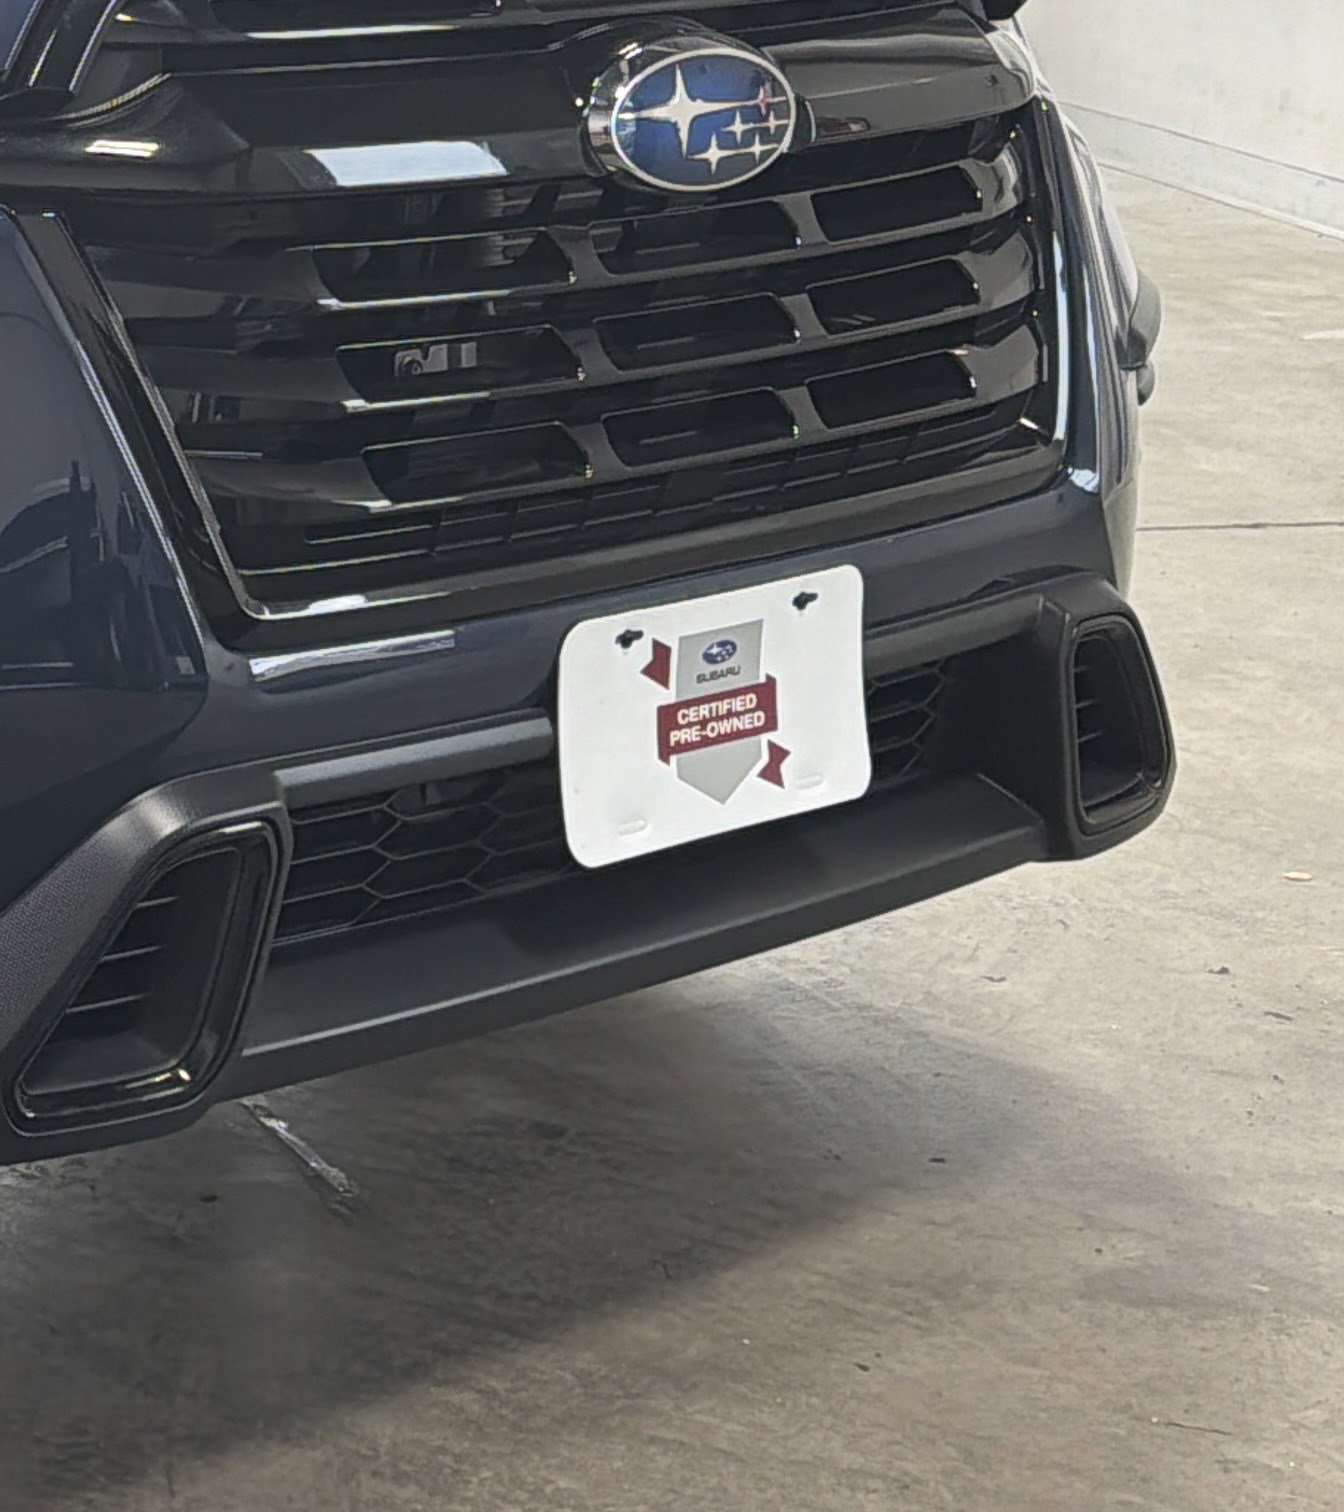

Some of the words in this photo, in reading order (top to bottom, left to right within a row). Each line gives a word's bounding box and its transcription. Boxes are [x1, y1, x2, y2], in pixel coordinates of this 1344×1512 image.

[696, 665, 741, 685] SUBARU
[676, 692, 758, 725] CERTIFIED
[669, 710, 766, 747] PRE-OWNED
